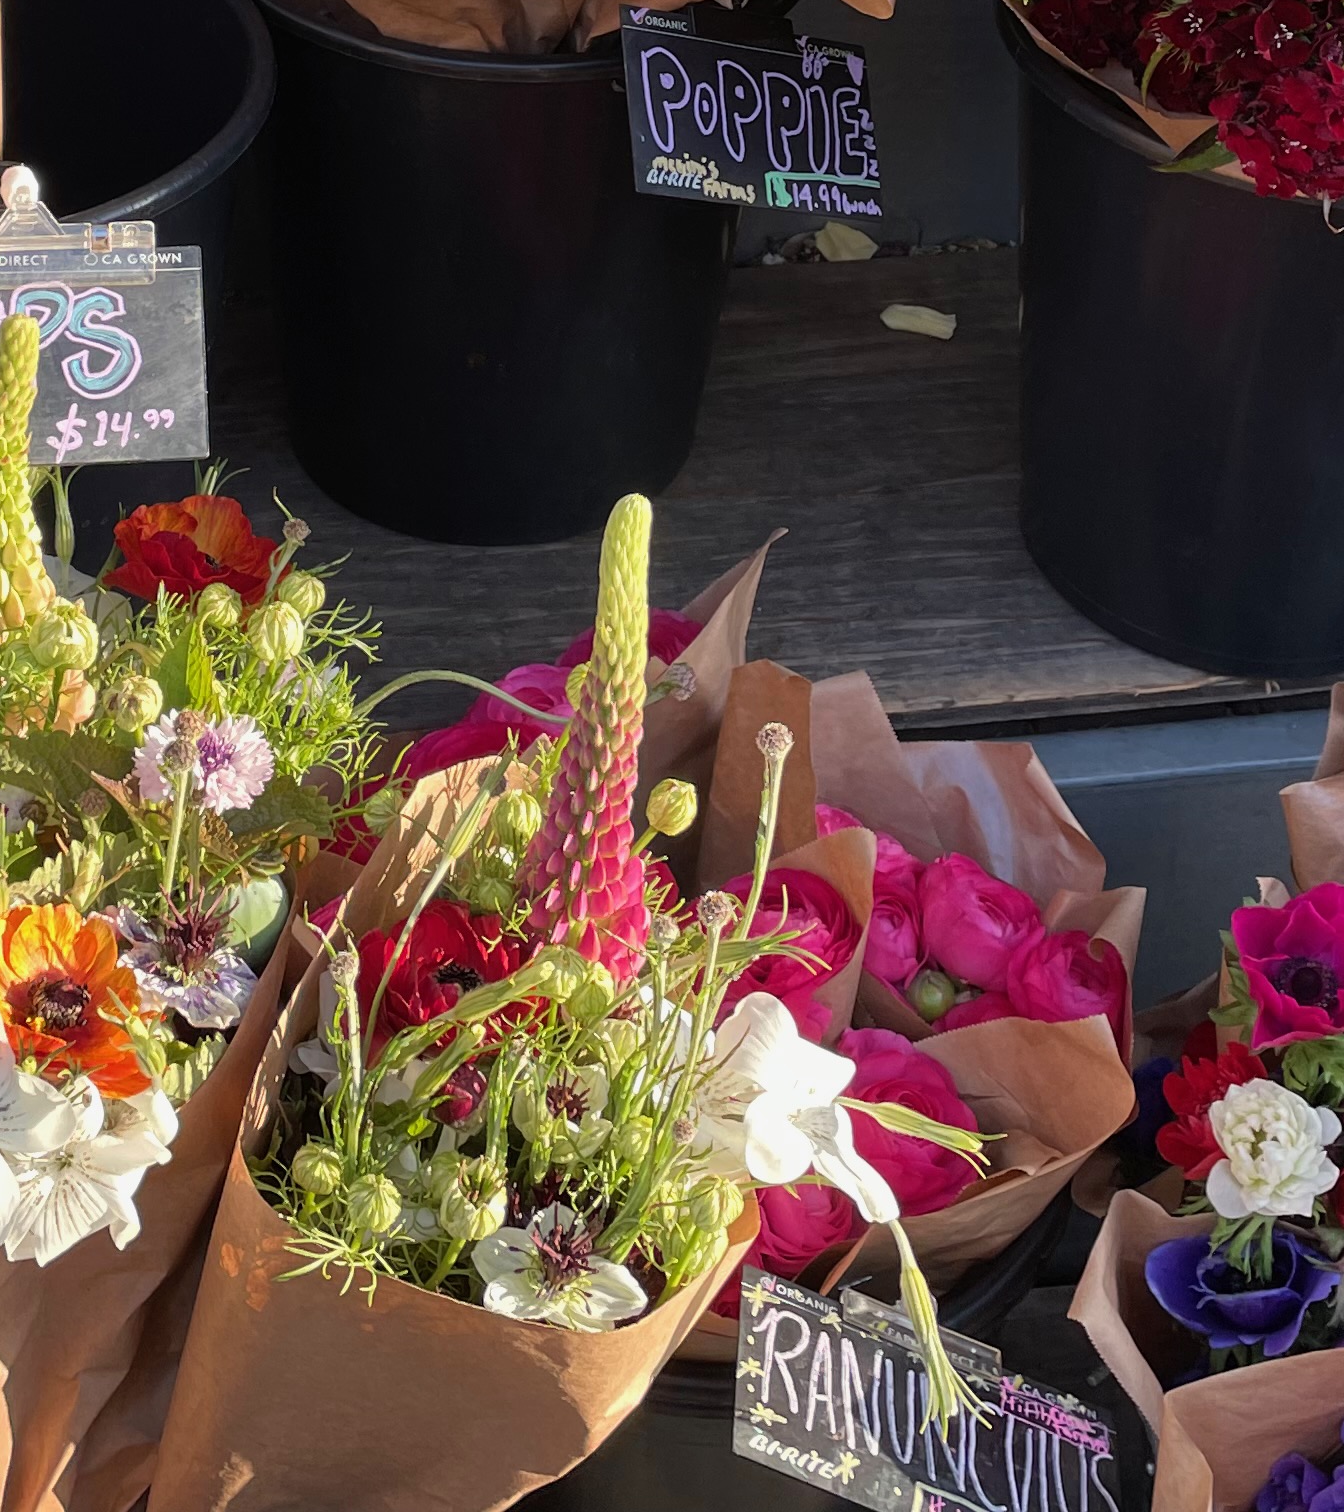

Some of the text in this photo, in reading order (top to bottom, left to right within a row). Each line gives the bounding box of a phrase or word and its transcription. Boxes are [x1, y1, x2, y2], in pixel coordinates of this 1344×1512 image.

[644, 15, 688, 32] ORGANIC
[101, 251, 183, 266] CA GROWN
[46, 402, 176, 465] $14.99
[775, 1285, 840, 1316] ORGANIC
